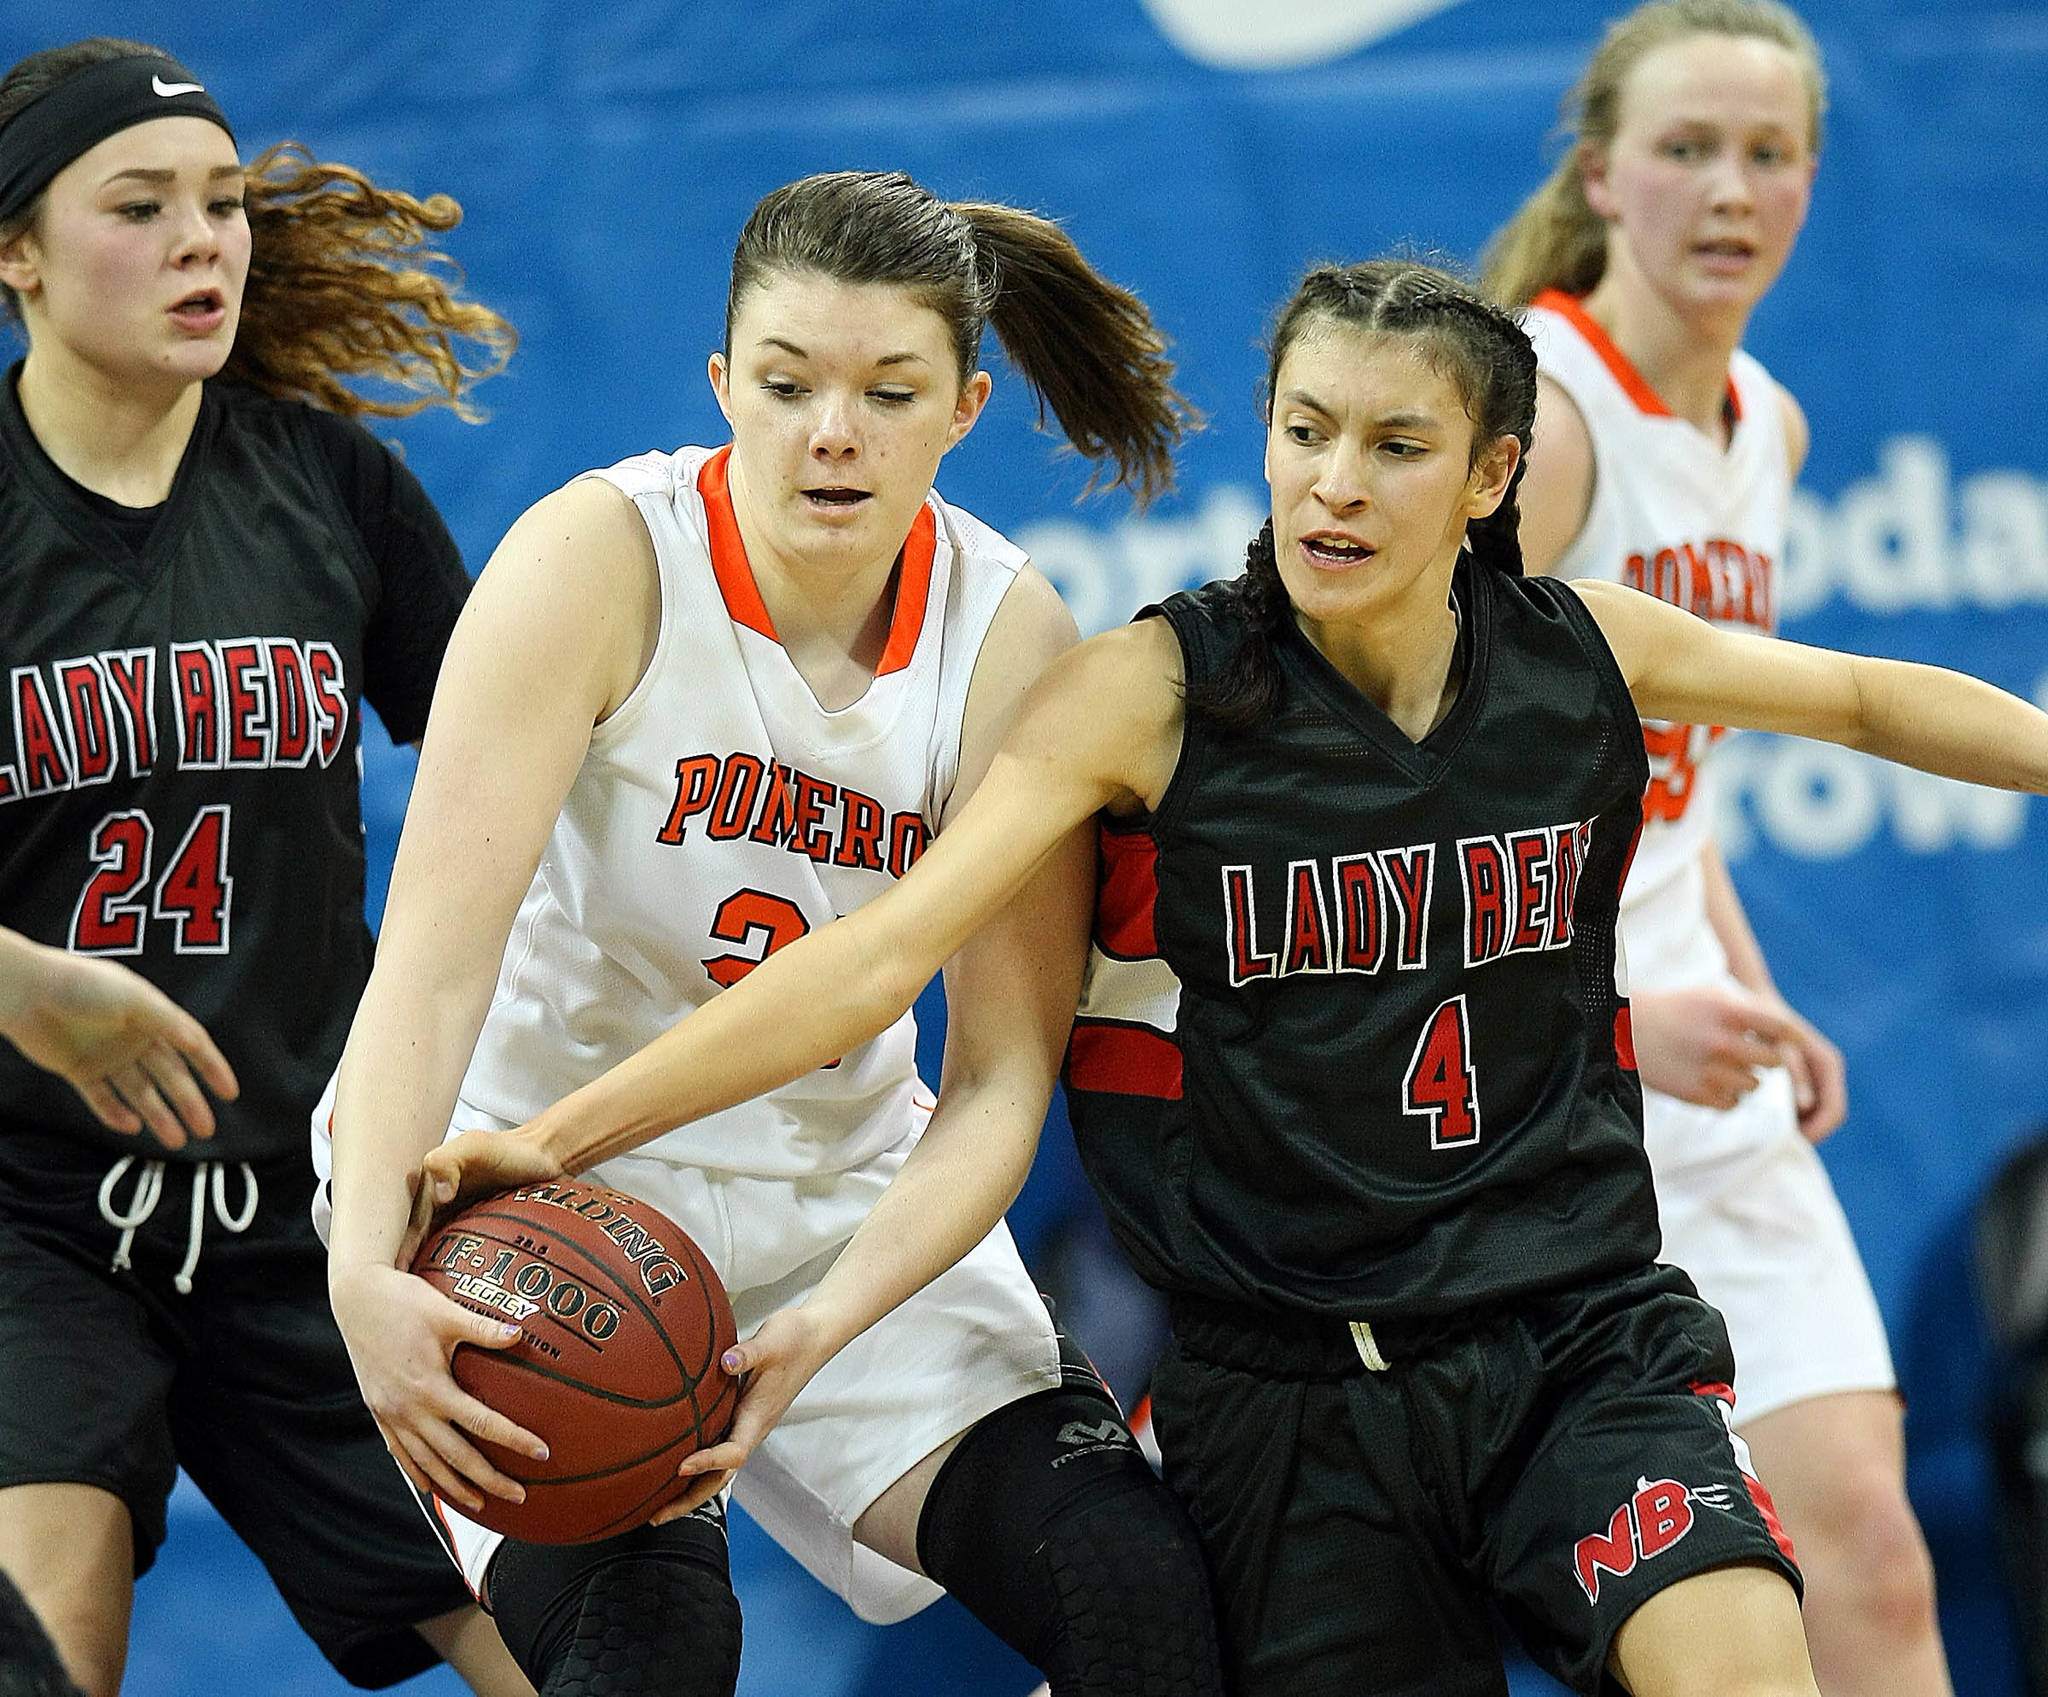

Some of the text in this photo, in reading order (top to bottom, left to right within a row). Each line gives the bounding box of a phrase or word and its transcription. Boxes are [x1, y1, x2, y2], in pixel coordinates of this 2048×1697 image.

[169, 637, 349, 771] REDS
[67, 804, 234, 956] 24
[655, 750, 935, 882] POMERO
[1221, 843, 1436, 989] LADY
[1402, 993, 1480, 1151] 4
[430, 1234, 621, 1341] TF-1000
[453, 1273, 542, 1321] LEGACY
[1573, 1476, 1696, 1607] NB
